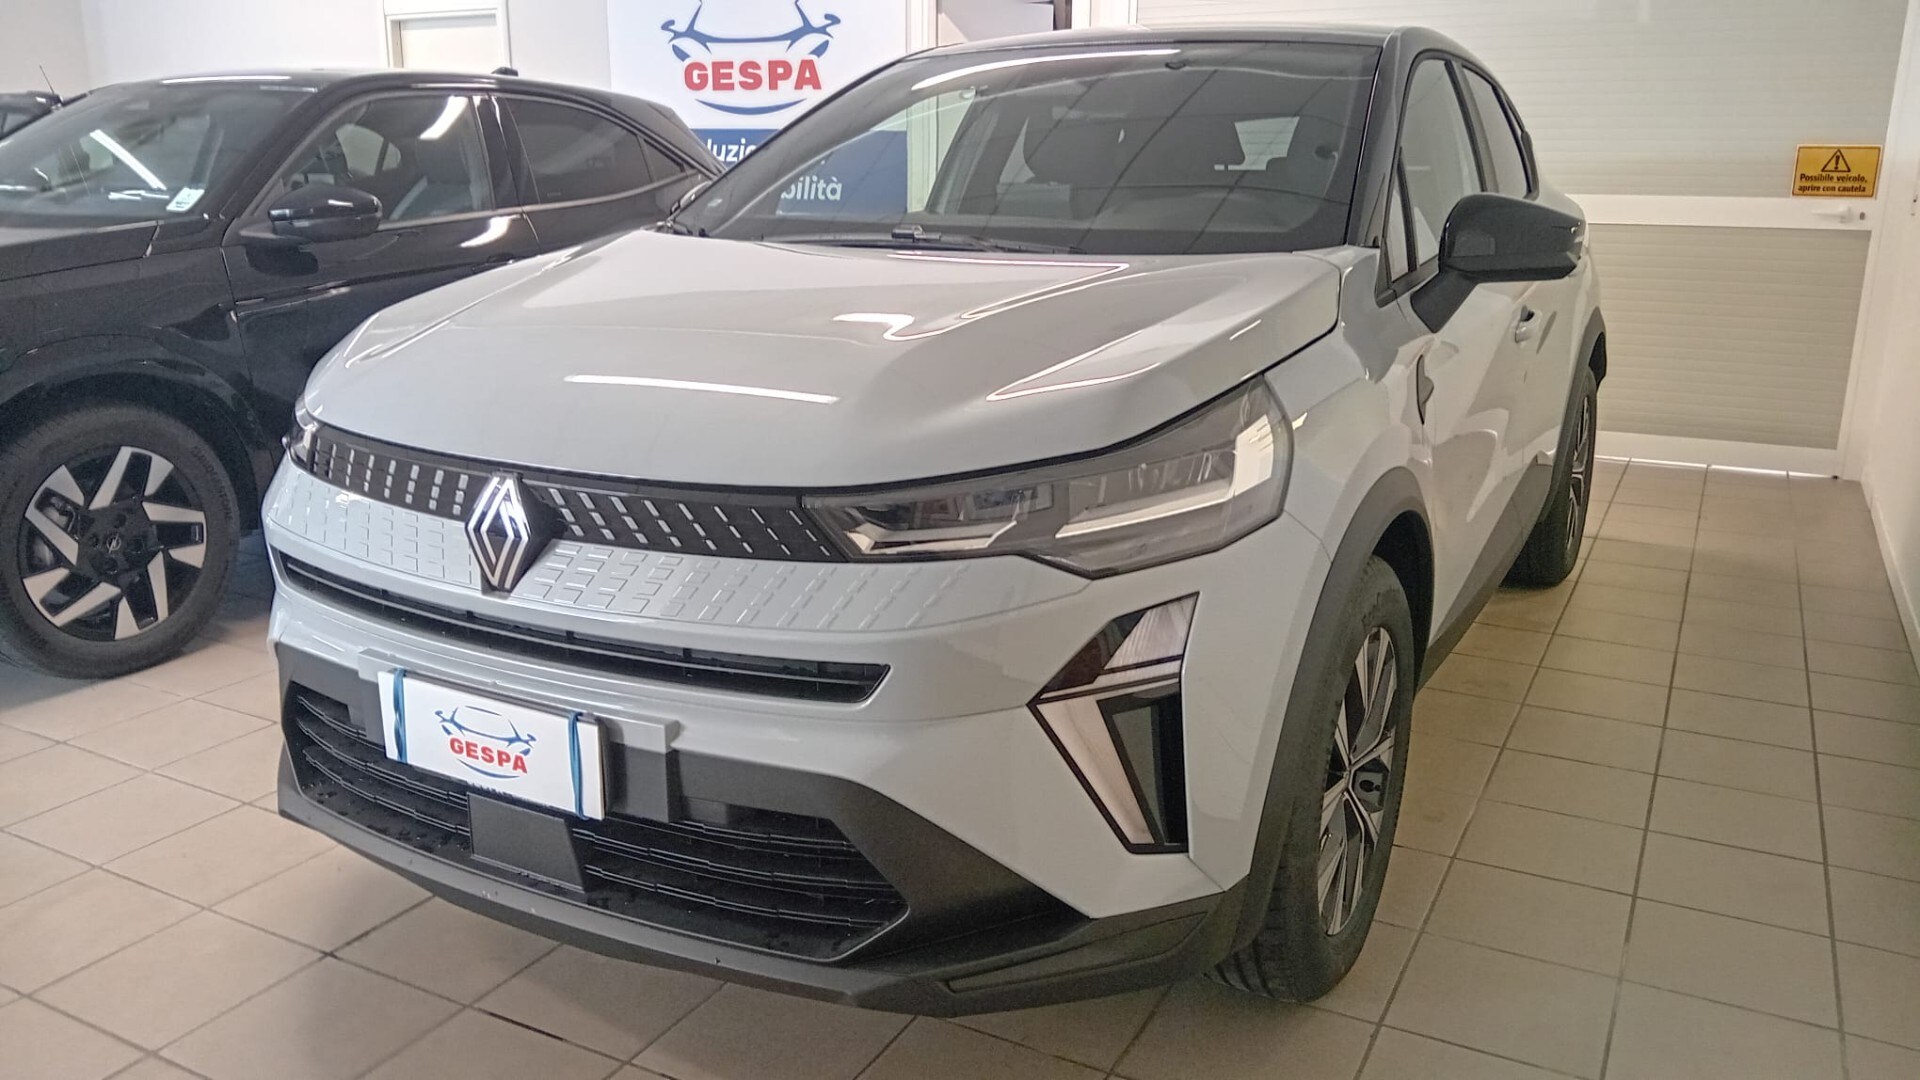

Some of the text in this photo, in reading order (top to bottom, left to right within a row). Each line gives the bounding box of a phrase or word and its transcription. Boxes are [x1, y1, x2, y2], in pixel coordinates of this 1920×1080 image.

[684, 59, 822, 91] GESPA
[1798, 184, 1821, 193] aprire
[1800, 173, 1868, 183] Possibile veicolo,
[450, 738, 528, 774] GESPA
